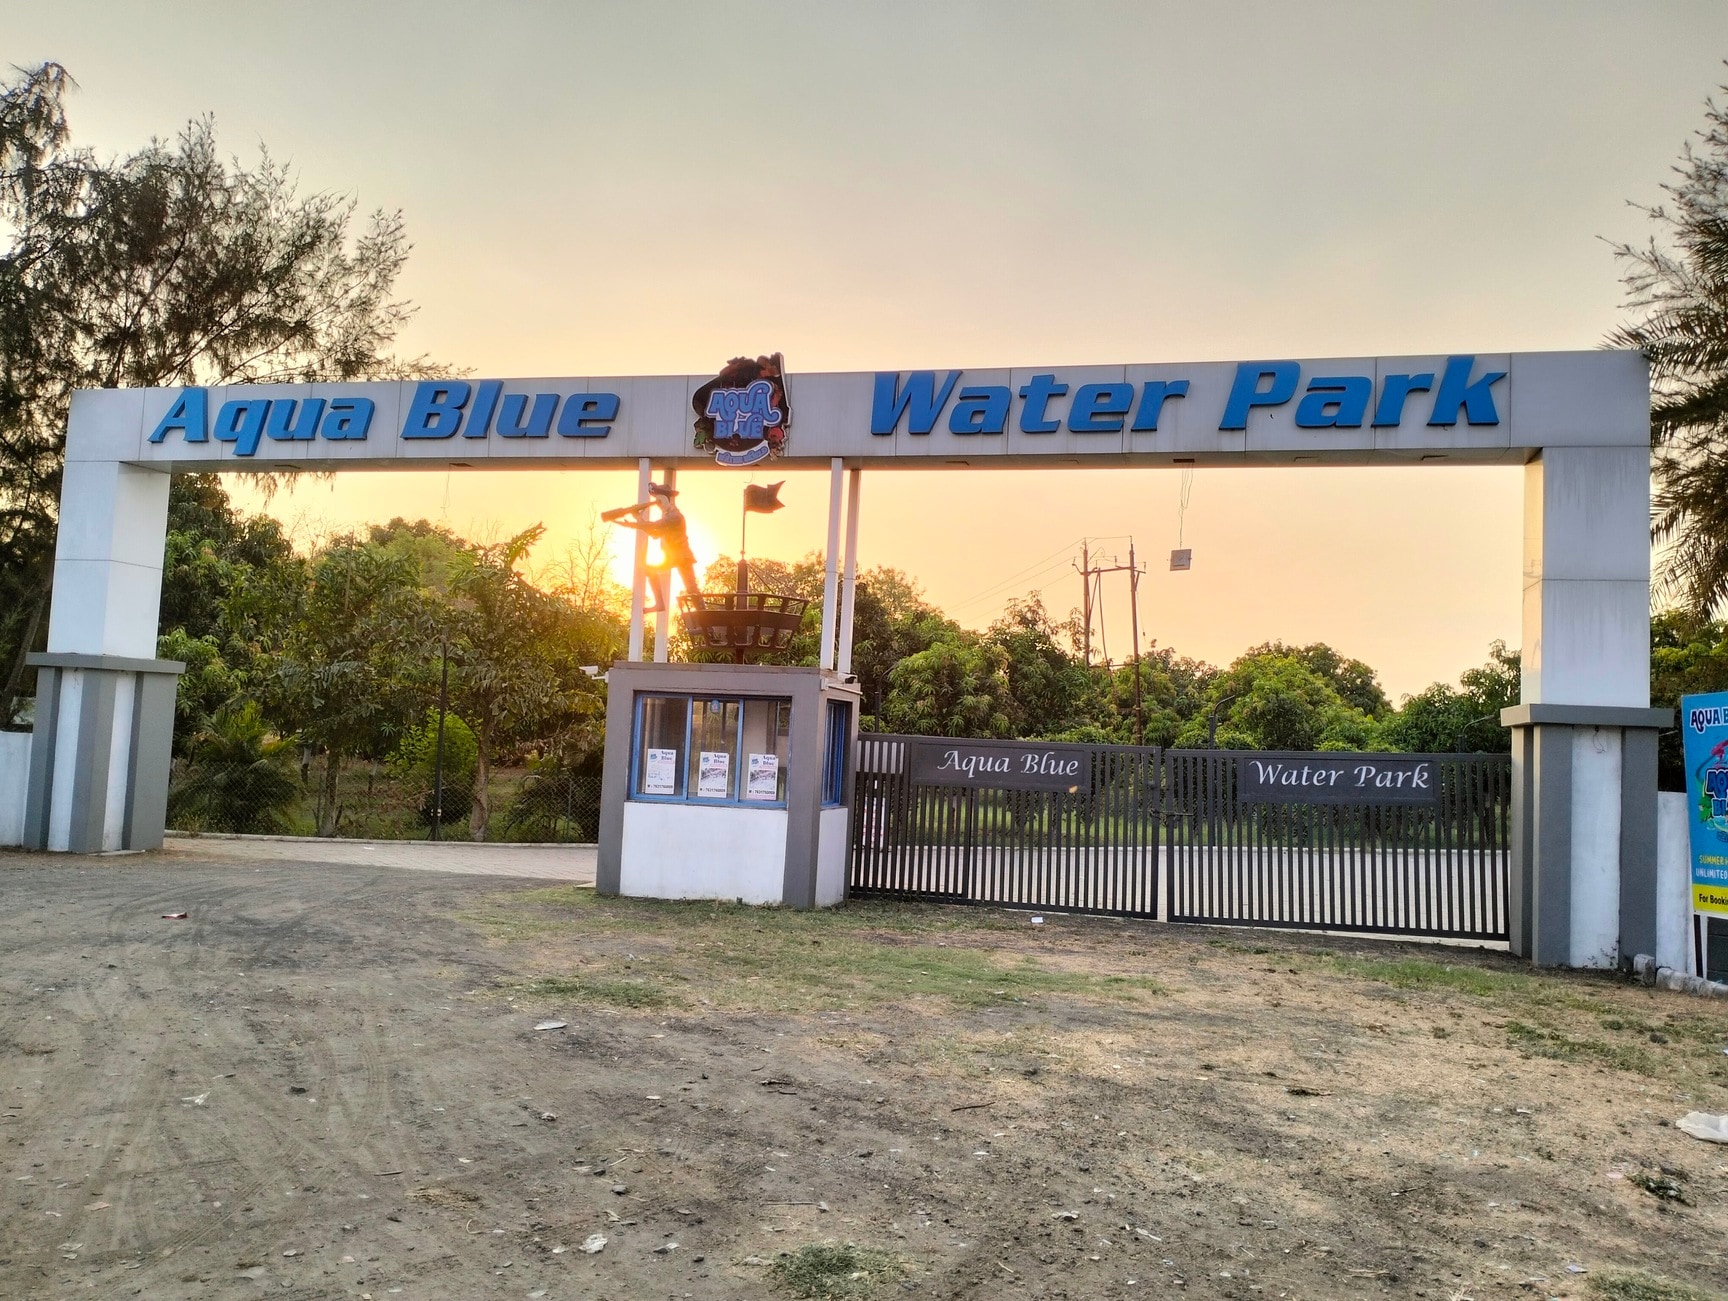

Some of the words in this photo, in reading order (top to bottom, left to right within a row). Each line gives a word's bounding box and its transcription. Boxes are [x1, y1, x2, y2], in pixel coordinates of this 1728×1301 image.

[708, 381, 781, 422] AQUA
[871, 370, 1190, 436] Water
[1219, 355, 1508, 431] Park
[148, 387, 374, 456] Aqua
[401, 380, 620, 440] Blue
[714, 414, 764, 440] BLUE
[1690, 707, 1721, 734] AQUA
[937, 751, 1011, 778] Aqua
[1020, 752, 1078, 776] Blue
[1249, 760, 1344, 786] Water
[1353, 763, 1430, 789] Park
[1696, 867, 1728, 879] UNLIMITED
[1699, 854, 1724, 866] SUMMER
[1699, 893, 1708, 903] For
